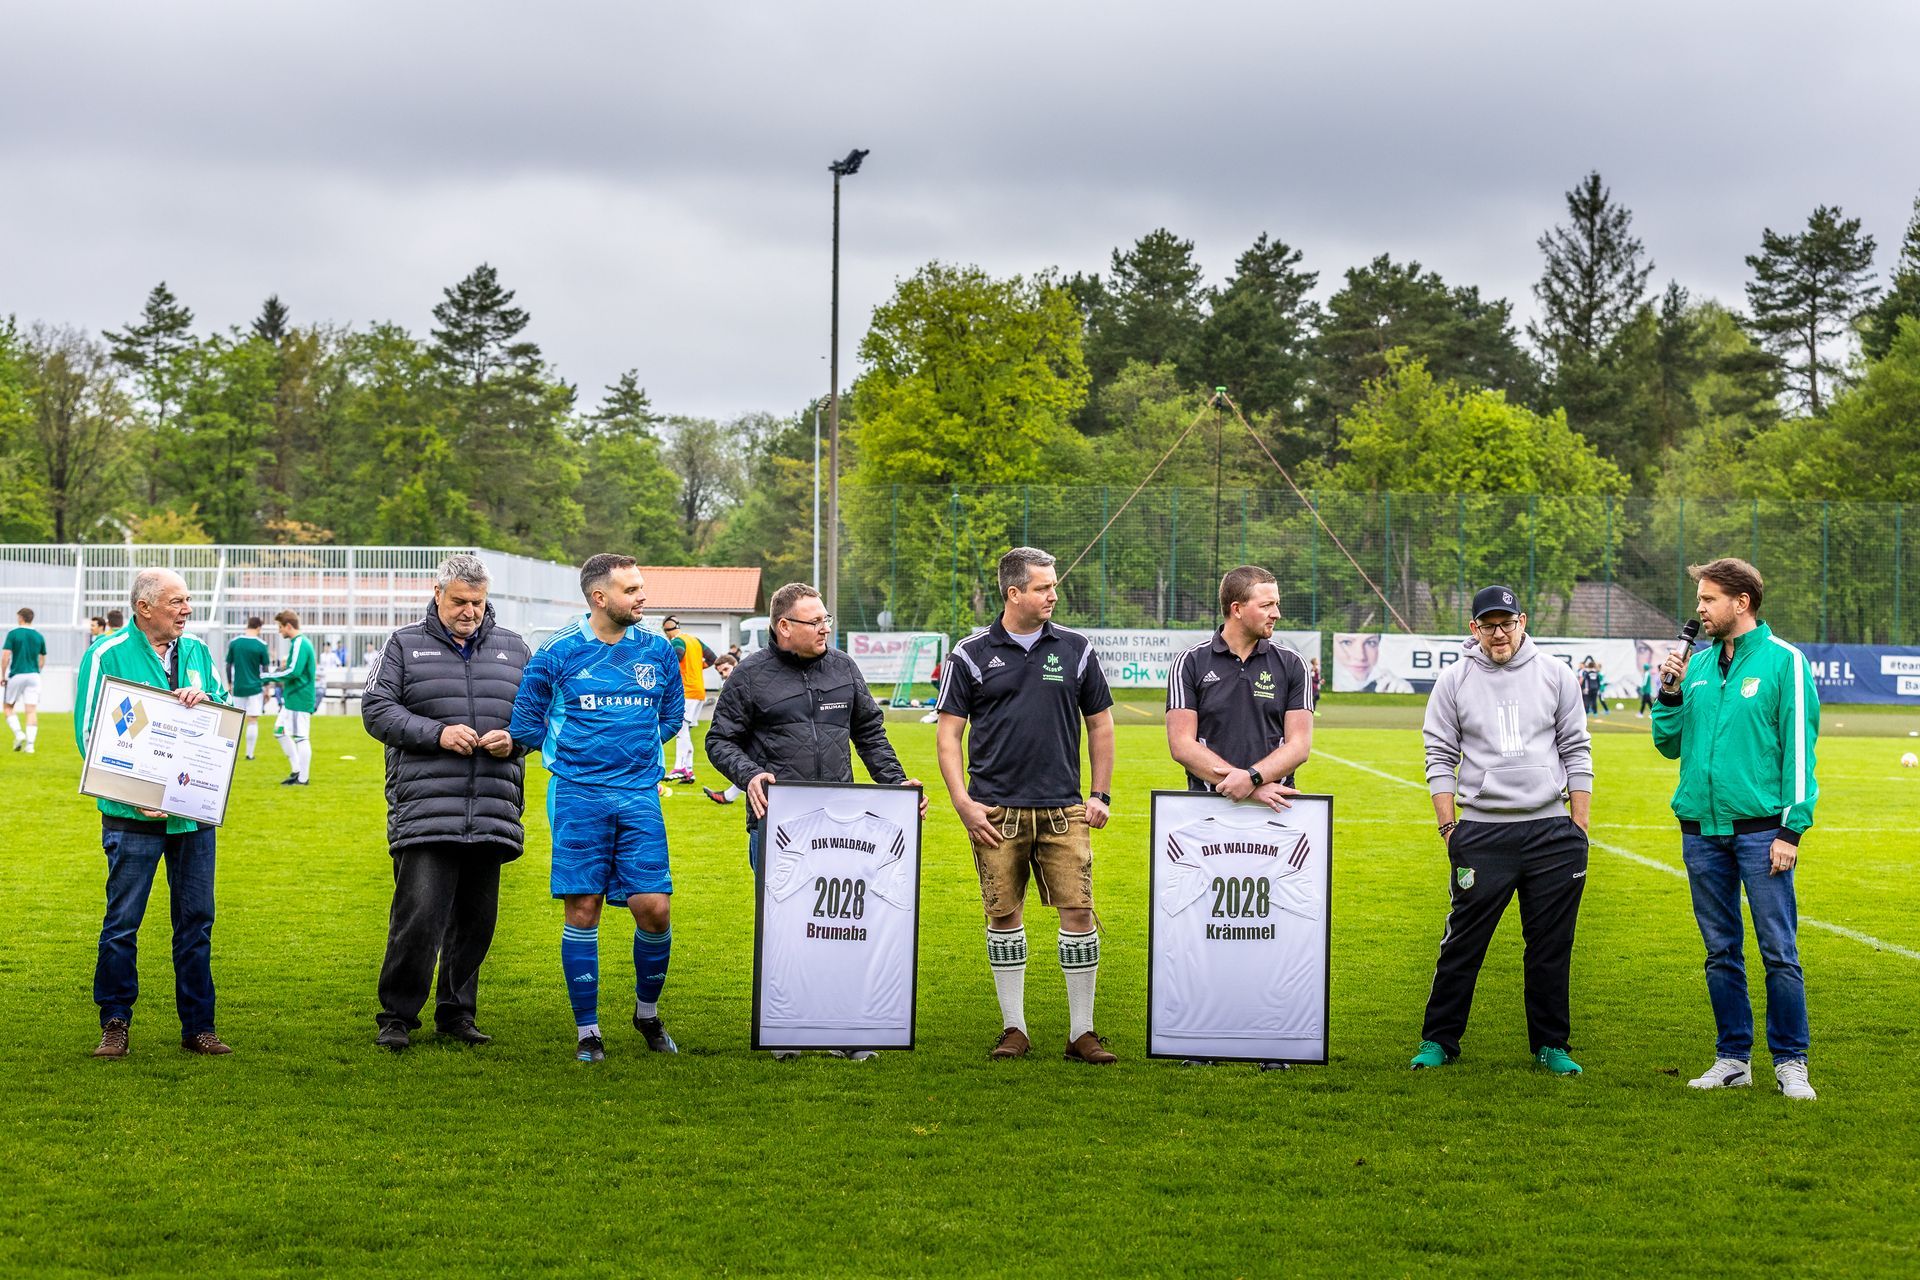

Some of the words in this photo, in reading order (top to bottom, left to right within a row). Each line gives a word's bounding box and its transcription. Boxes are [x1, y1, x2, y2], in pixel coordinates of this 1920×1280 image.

[1133, 636, 1170, 647] STARK!
[1105, 667, 1119, 678] die
[1123, 663, 1150, 683] DJK
[116, 740, 133, 749] 2014
[811, 838, 828, 851] DJK
[829, 838, 877, 855] WALDRAM
[1201, 843, 1222, 857] DJK
[1223, 842, 1279, 857] WALDRAM
[813, 876, 866, 920] 2028
[1211, 876, 1270, 919] 2028
[806, 922, 867, 941] Brumaba
[1206, 923, 1276, 940] Krämmel
